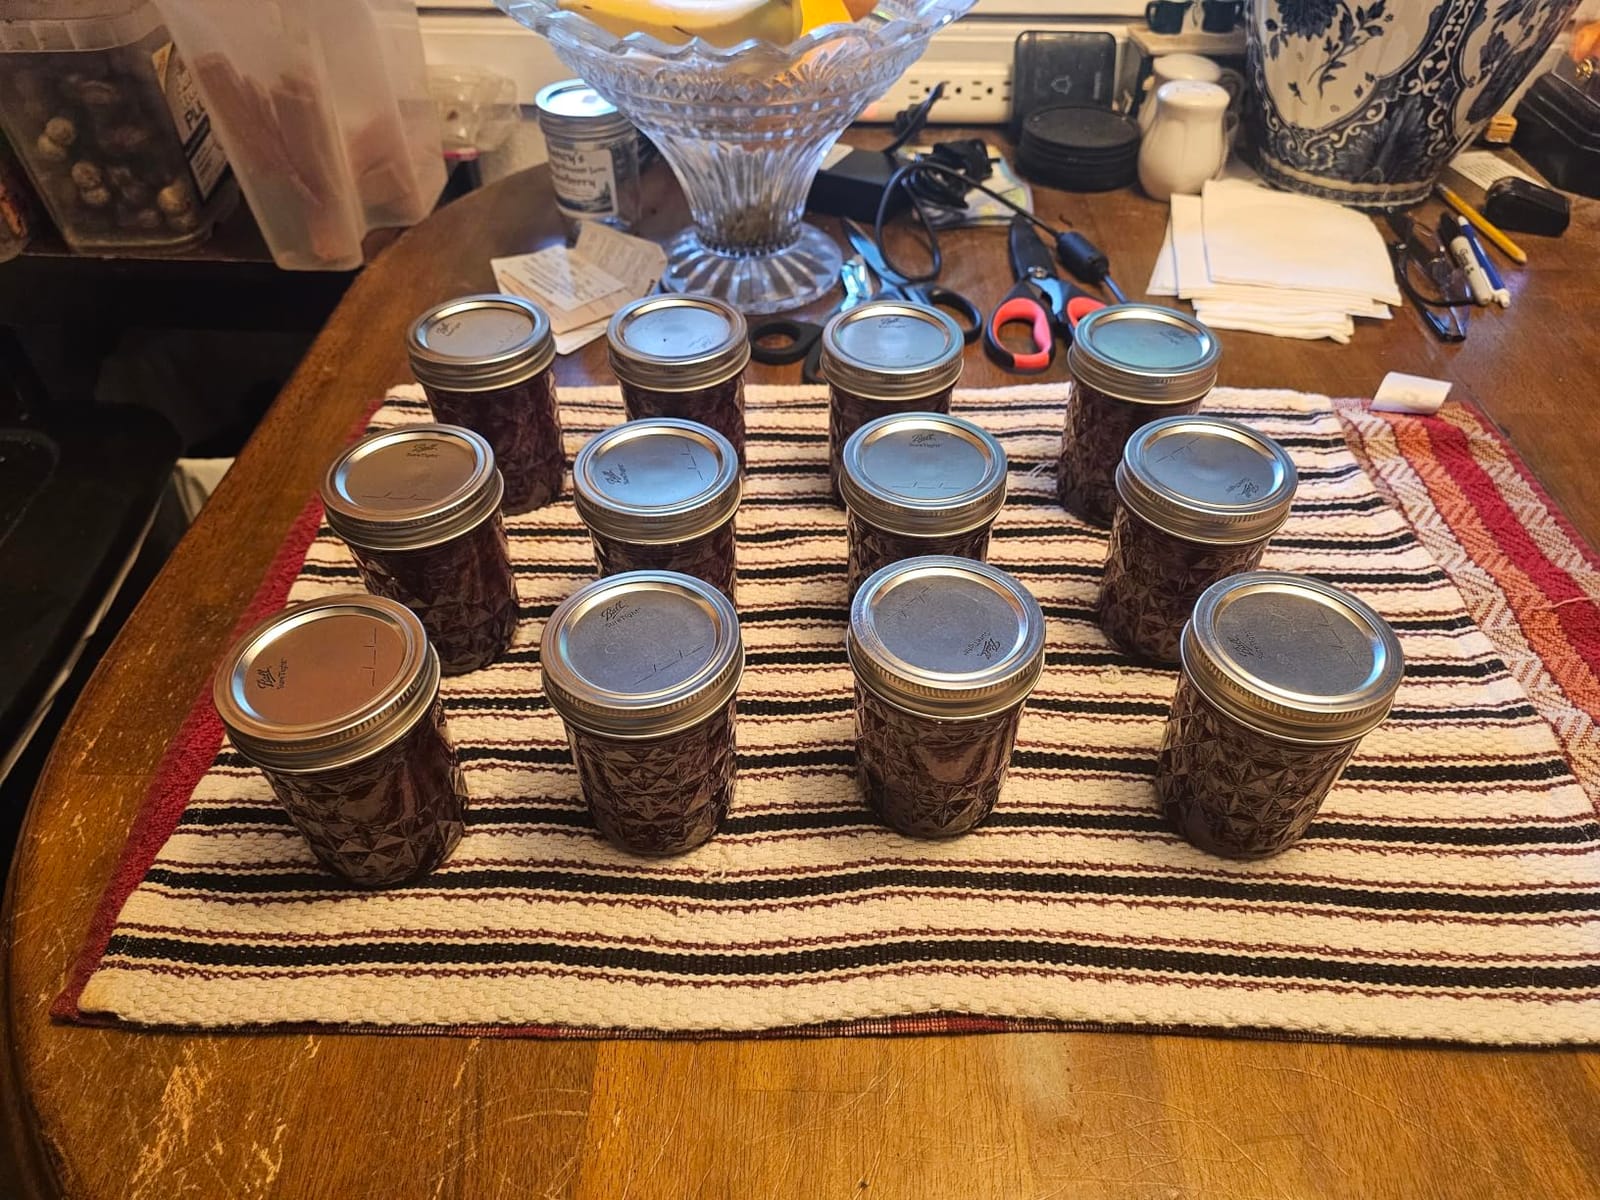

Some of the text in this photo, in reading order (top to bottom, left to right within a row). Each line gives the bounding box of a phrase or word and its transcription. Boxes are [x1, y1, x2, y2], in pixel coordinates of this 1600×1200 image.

[601, 600, 626, 621] Ball
[979, 638, 1001, 660] Ball
[256, 665, 276, 689] Ball
